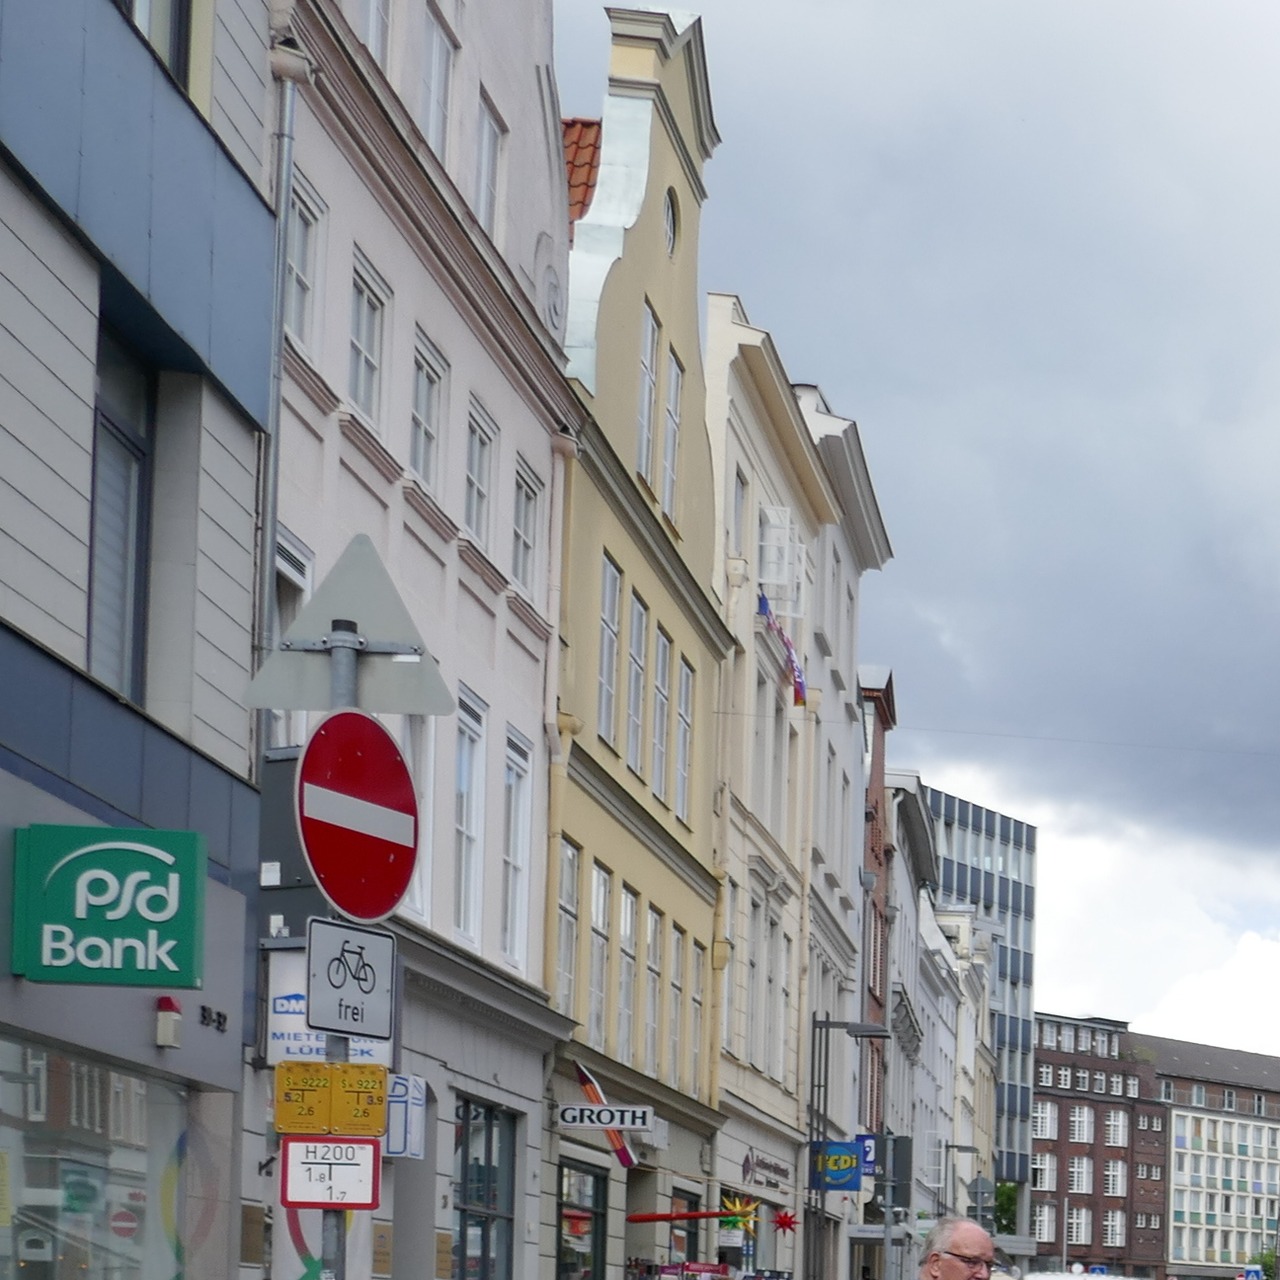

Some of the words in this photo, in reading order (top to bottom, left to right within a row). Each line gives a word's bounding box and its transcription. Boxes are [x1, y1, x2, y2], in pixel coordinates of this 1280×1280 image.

[74, 868, 180, 923] psd
[41, 924, 180, 972] Bank
[338, 998, 365, 1023] frei
[560, 1107, 647, 1126] GROTH
